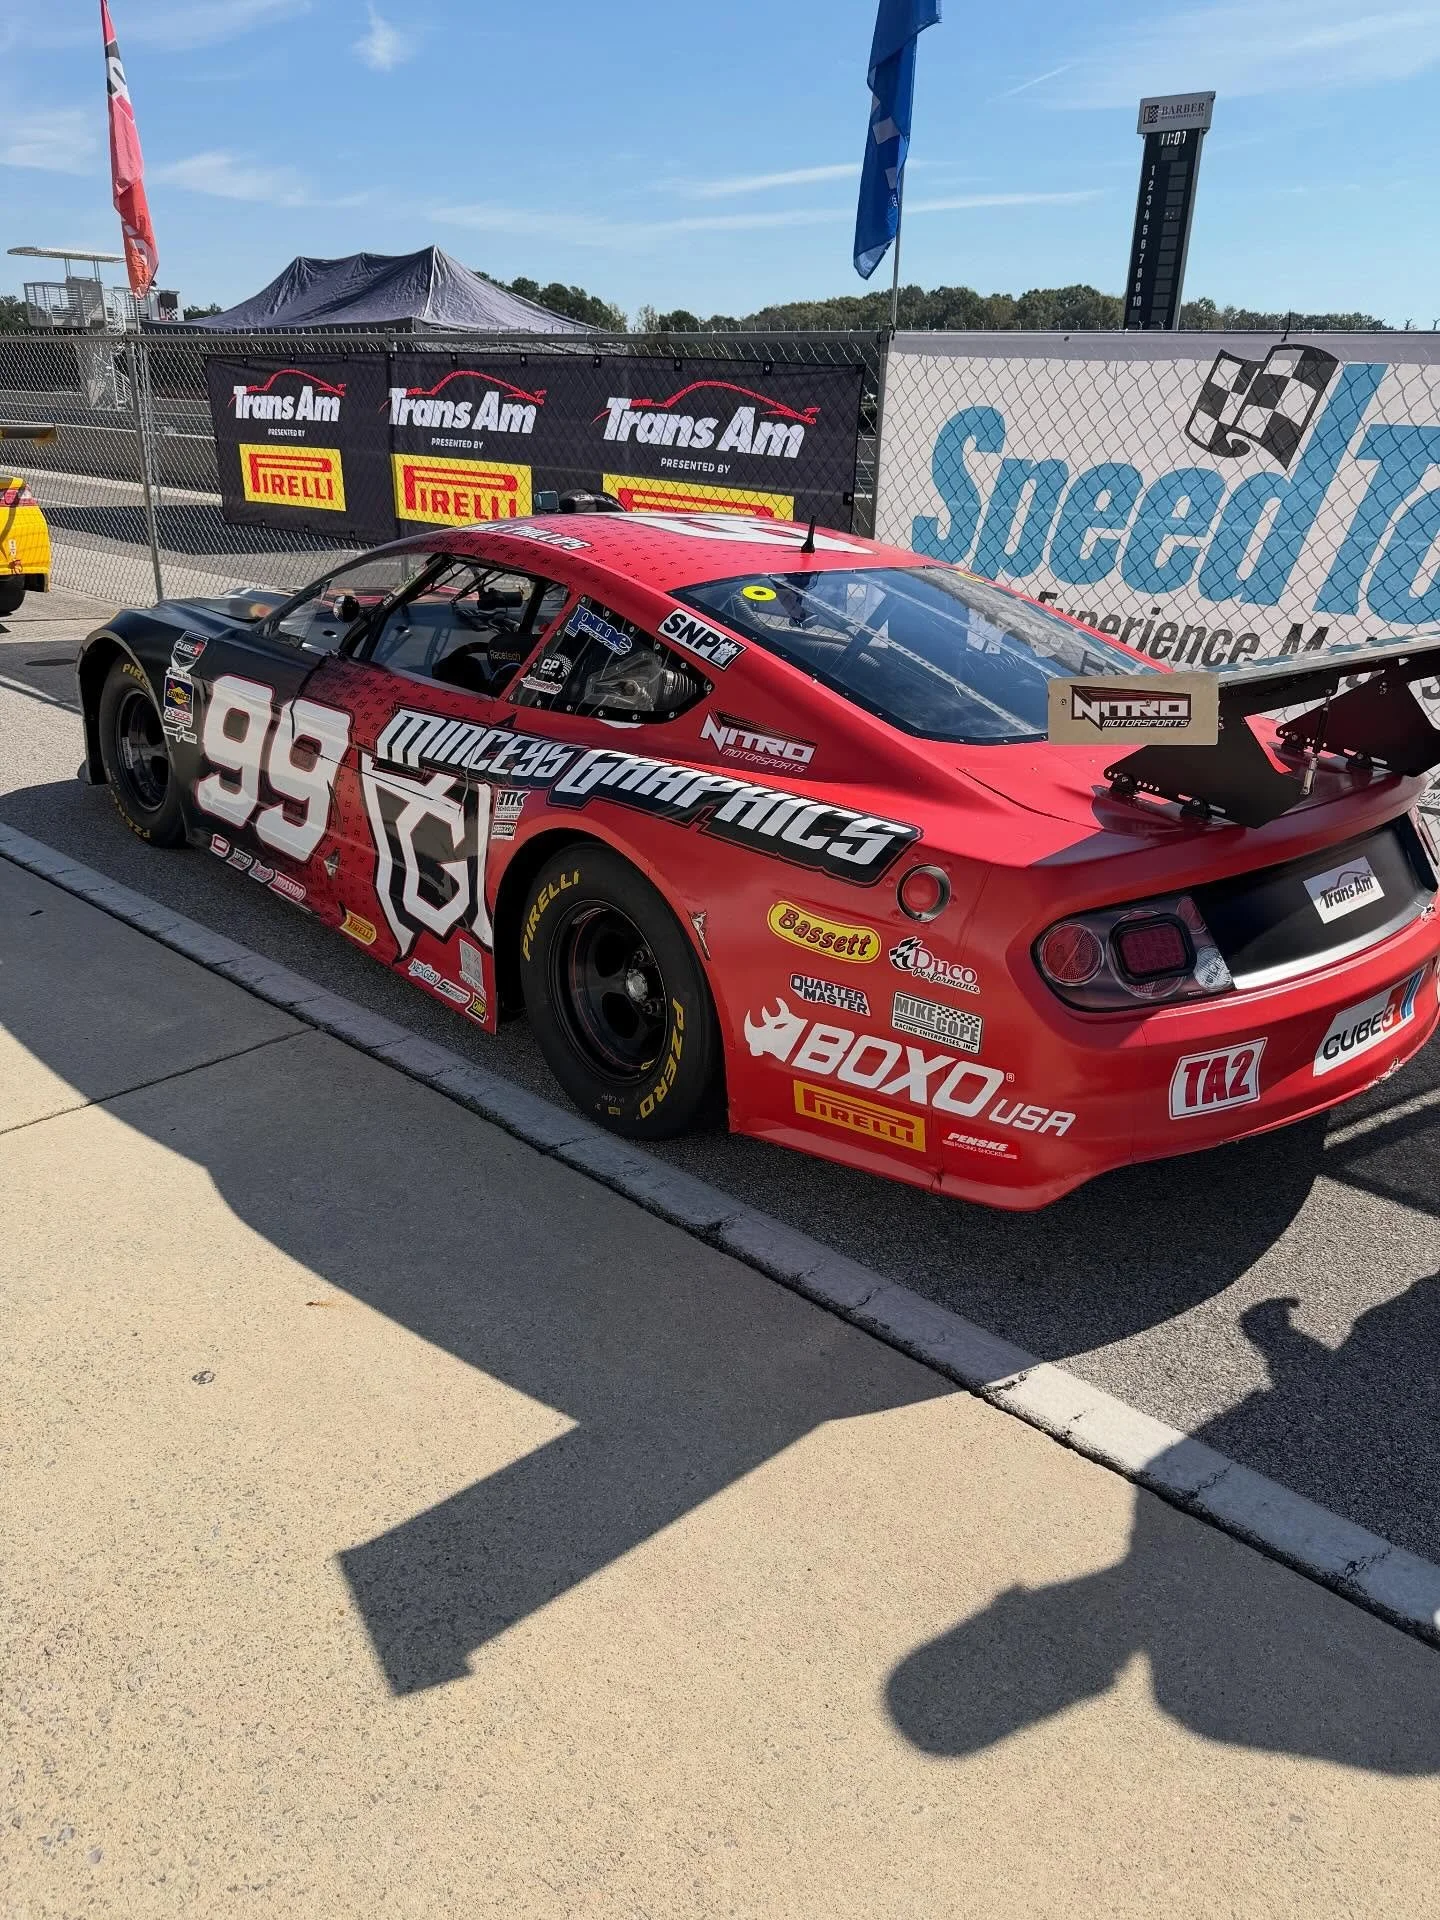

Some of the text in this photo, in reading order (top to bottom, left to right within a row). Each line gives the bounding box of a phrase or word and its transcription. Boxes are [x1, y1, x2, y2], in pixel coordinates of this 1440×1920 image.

[1161, 102, 1205, 115] BARBER
[1160, 130, 1187, 146] 11:07
[1151, 165, 1156, 176] 1
[1147, 180, 1154, 191] 2
[1145, 195, 1152, 206] 3
[1143, 209, 1150, 221] 4
[1142, 224, 1148, 236] 5
[1140, 239, 1147, 250] 6
[1139, 253, 1145, 264] 7
[1137, 268, 1143, 278] 8
[1135, 282, 1141, 293] 9
[1132, 295, 1142, 307] 10
[233, 385, 341, 422] Trans Am
[388, 388, 538, 434] Trans Am
[267, 428, 306, 438] PRESENTED BY
[602, 397, 805, 459] Trans Am
[431, 437, 485, 450] PRESENTED BY
[249, 453, 334, 501] PIRELLI
[660, 457, 731, 475] PRESENTED BY
[402, 464, 519, 521] PIRELLI
[175, 641, 201, 656] CUBE3
[541, 658, 560, 671] CP
[168, 689, 191, 702] SUNOCO
[1073, 695, 1190, 728] NITRO
[1102, 718, 1190, 728] MOTORSPORTS
[700, 713, 817, 764] NITRO
[196, 674, 354, 863] 99
[723, 748, 808, 773] MOTORSPORTS
[1320, 884, 1356, 909] Trans
[1354, 876, 1374, 895] Am
[522, 868, 580, 962] PIRELLI
[348, 917, 374, 939] PIRELLI
[778, 908, 872, 956] Bassett
[911, 946, 978, 984] Duco
[790, 974, 865, 1002] QUARTER
[912, 967, 980, 993] Performance
[803, 990, 868, 1015] MASTER
[894, 997, 936, 1023] MIKE
[894, 1022, 977, 1052] RACING ENTERPRISES, INC.
[935, 1017, 980, 1043] COPE
[1322, 1002, 1396, 1060] CUBE3
[791, 1024, 1077, 1137] BOXO USA
[1184, 1049, 1255, 1108] TA2
[803, 1087, 915, 1143] PIRELLI
[947, 1132, 1009, 1152] PENSKE
[954, 1141, 977, 1152] RACING
